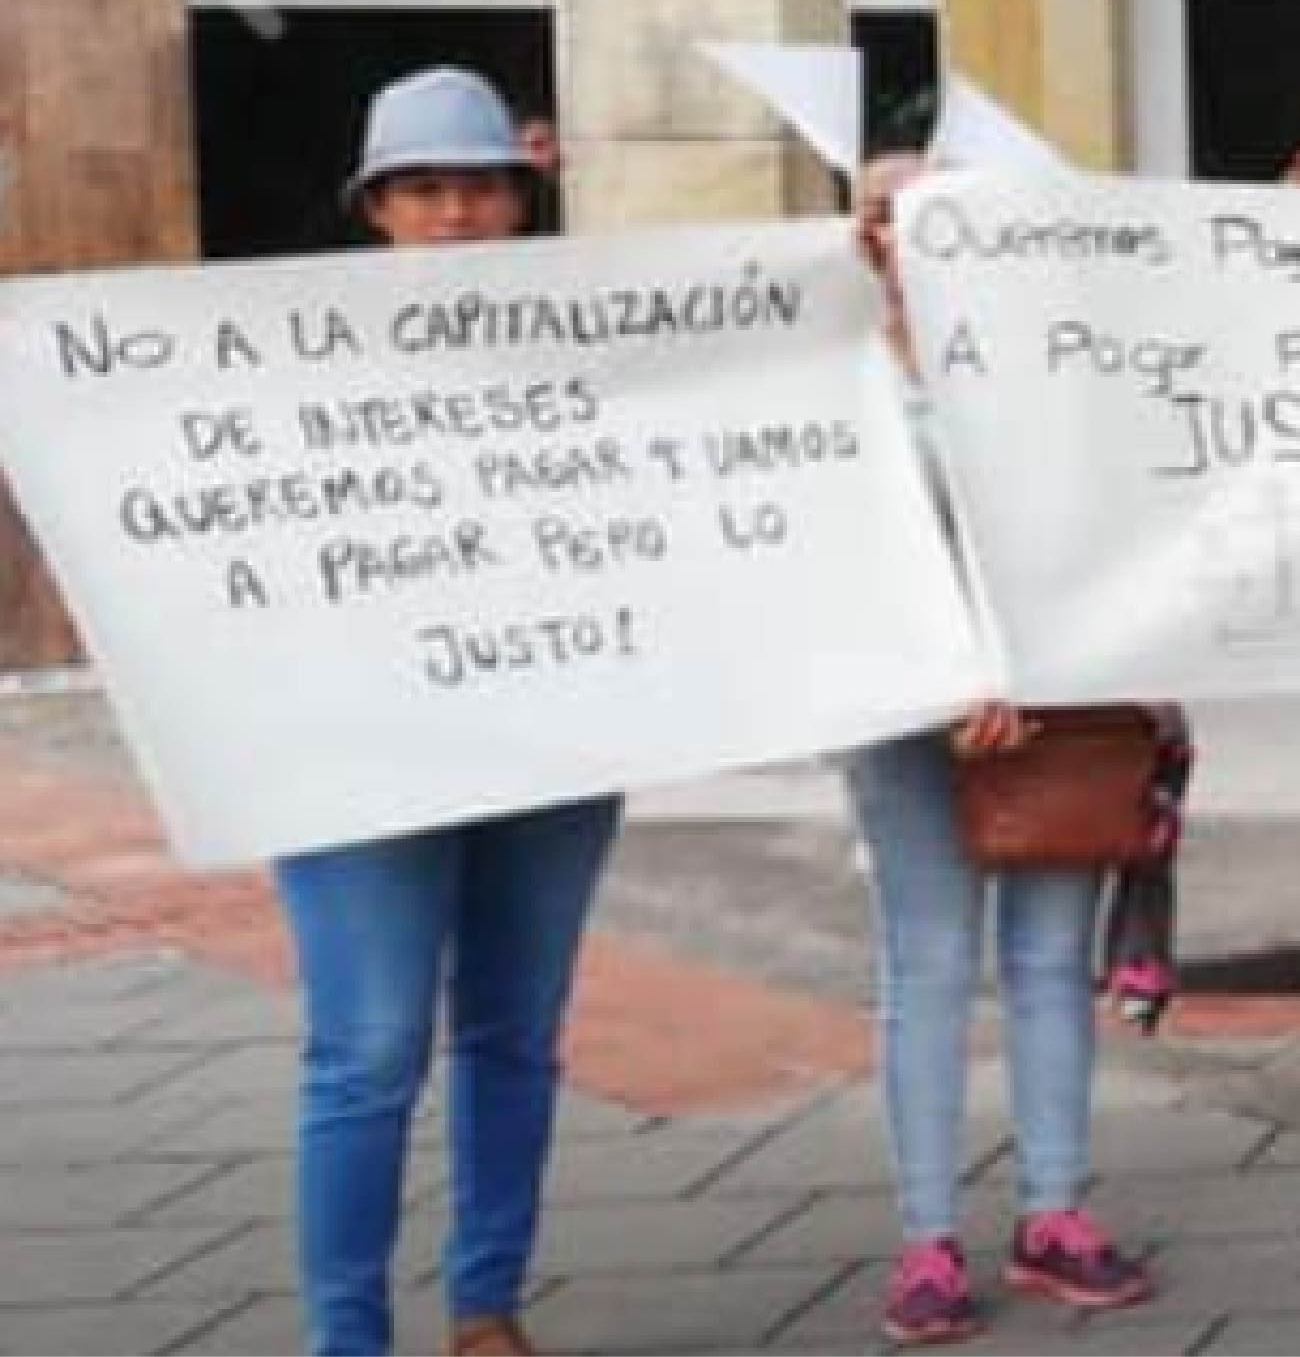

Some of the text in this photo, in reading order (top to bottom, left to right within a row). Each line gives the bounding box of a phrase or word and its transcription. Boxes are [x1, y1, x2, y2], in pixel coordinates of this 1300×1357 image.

[215, 319, 261, 368] A
[289, 301, 358, 361] LA
[943, 321, 984, 374] A
[180, 376, 600, 460] DE INTERESES
[119, 456, 444, 546] QUEREMOS
[477, 442, 630, 500] PAGAR
[707, 421, 861, 478] VAMOS
[225, 561, 267, 608] A
[319, 524, 498, 604] PAGAR
[717, 505, 787, 549] LO
